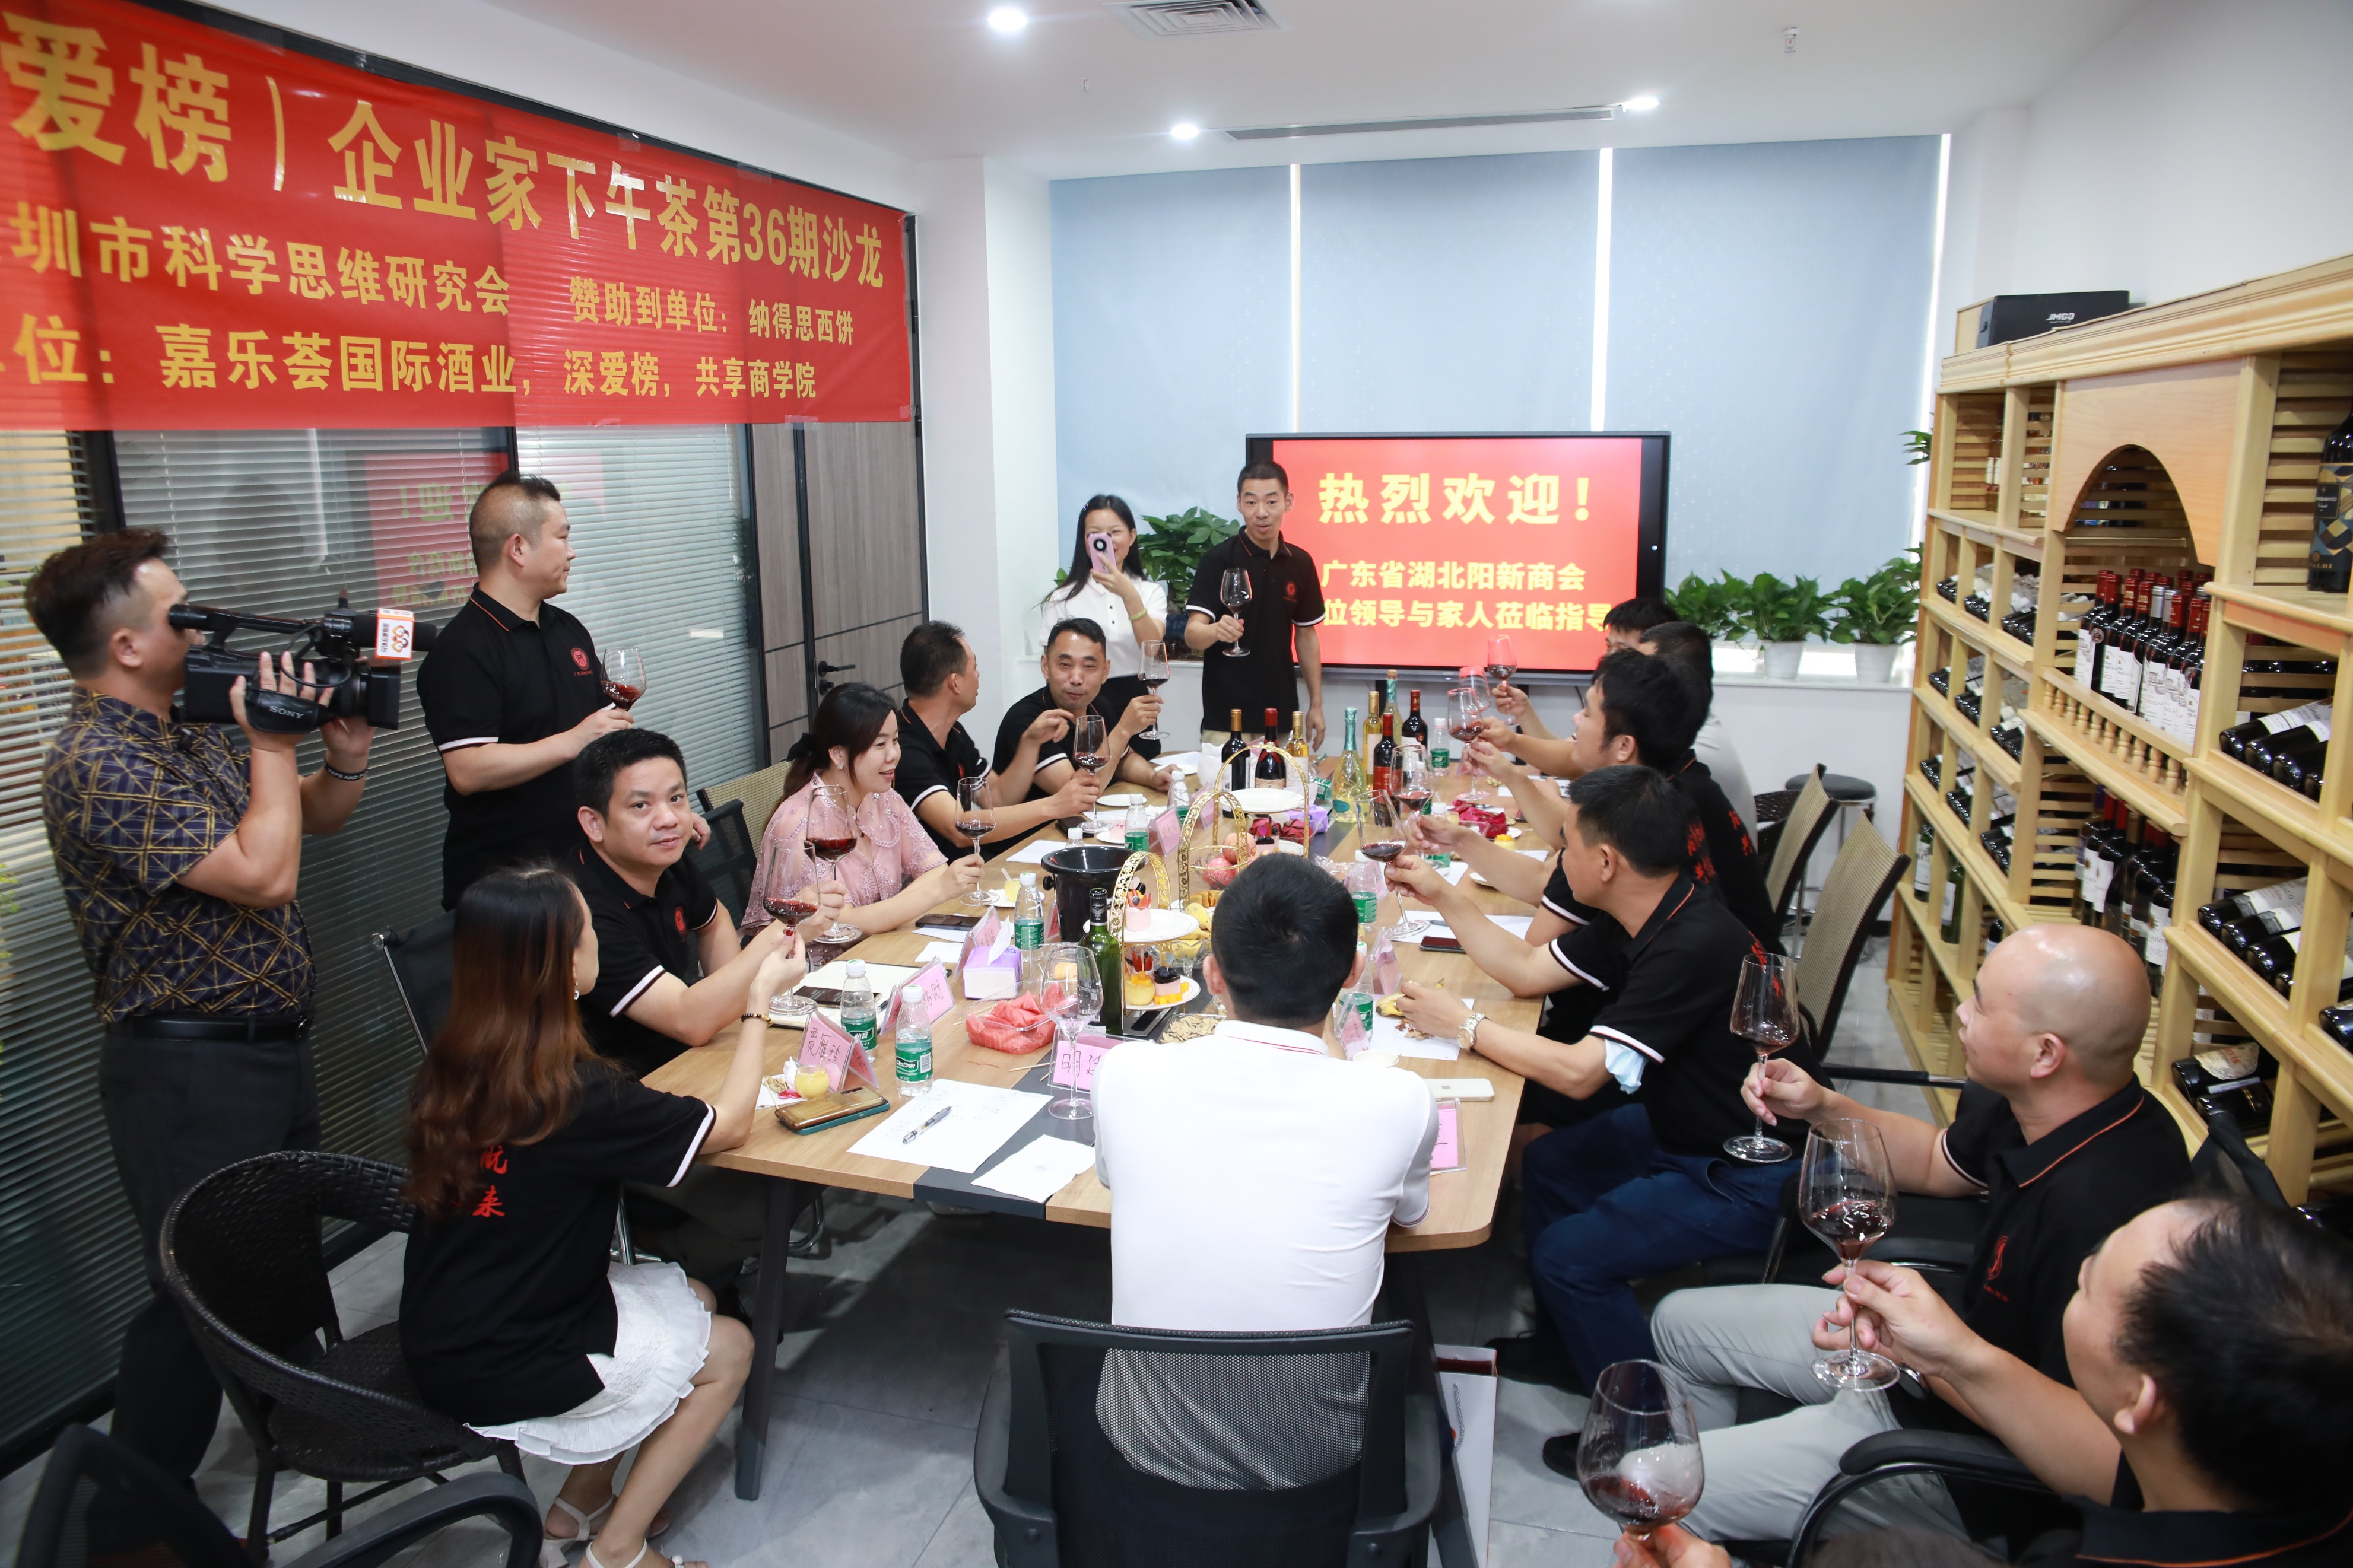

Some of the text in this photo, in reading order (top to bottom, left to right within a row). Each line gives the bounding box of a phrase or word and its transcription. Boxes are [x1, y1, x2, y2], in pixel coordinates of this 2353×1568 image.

[8, 201, 509, 316] 圳市科学思维研究会
[1320, 559, 1586, 591] 广东省湖北阳新商会
[1323, 598, 1612, 632] 位领导与家人莅临指导
